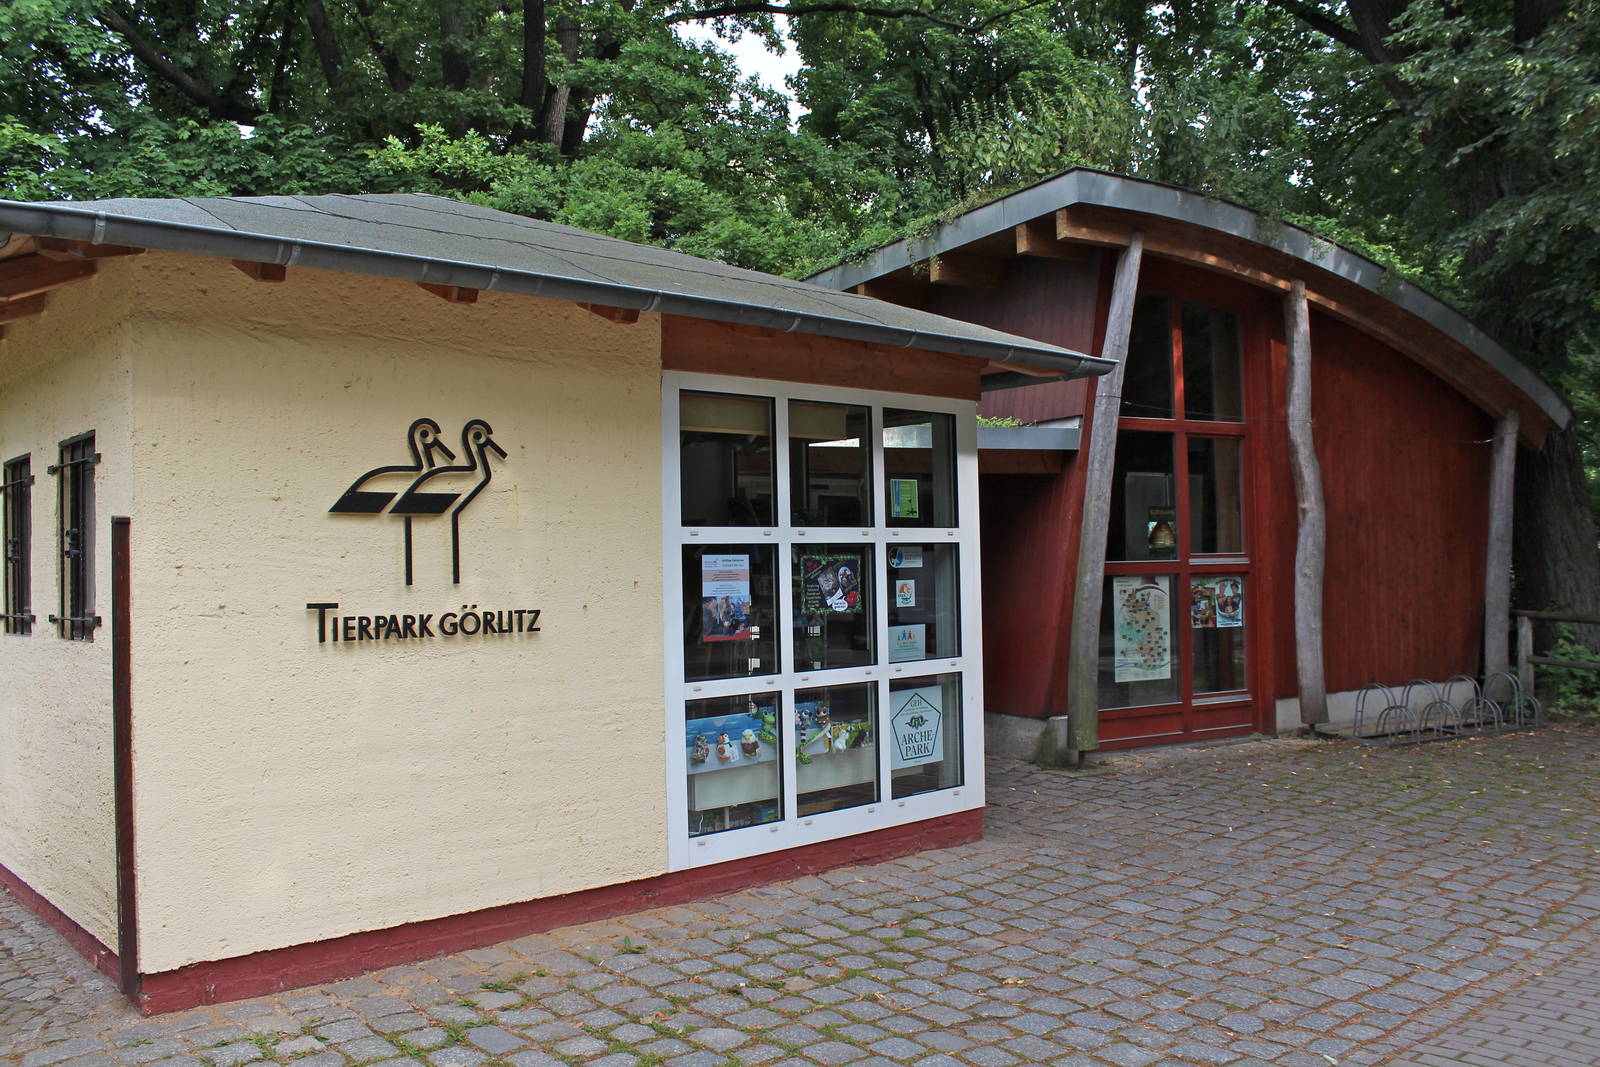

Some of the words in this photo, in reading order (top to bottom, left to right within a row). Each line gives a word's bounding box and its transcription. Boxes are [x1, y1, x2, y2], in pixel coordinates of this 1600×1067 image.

[306, 602, 434, 643] TIERPARK
[439, 604, 541, 636] GÖRLITZ
[905, 742, 930, 757] PARK
